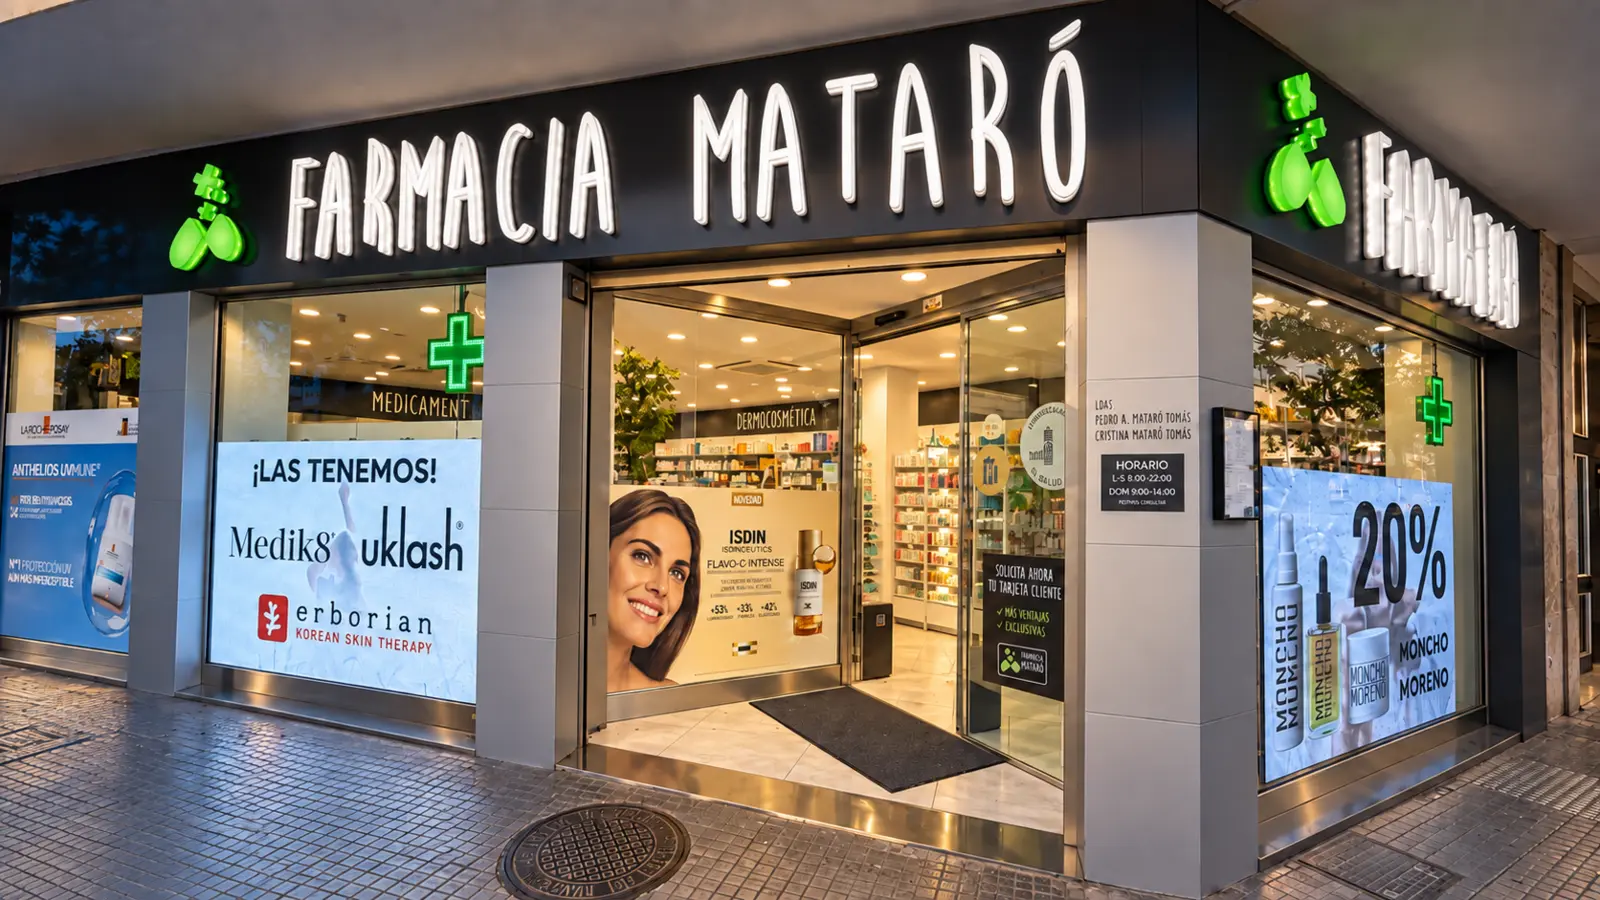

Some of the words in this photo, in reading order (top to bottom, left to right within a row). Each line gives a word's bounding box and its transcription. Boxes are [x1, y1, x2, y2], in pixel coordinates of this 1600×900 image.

[286, 111, 616, 262] FARMACIA
[693, 19, 1087, 225] MATARÓ
[372, 391, 470, 419] MEDICAMENT
[737, 405, 816, 430] DERMOCOSMÉTICA
[1095, 414, 1119, 425] PEDRO
[1121, 413, 1130, 424] A.
[1132, 411, 1163, 424] MATARÓ
[1165, 410, 1192, 424] TOMÁS
[1095, 430, 1130, 441] CRISTINA
[1132, 426, 1163, 440] MATARÓ
[1165, 426, 1192, 440] TOMÁS
[12, 463, 58, 476] ANTHELIOS
[252, 458, 301, 488] ¡LAS
[308, 458, 437, 484] TENEMOS!
[1116, 460, 1169, 470] HORARIO
[1112, 474, 1126, 482] L-S
[733, 494, 762, 505] NOVEDAD
[1109, 488, 1130, 496] DOM
[730, 530, 766, 544] ISDIN
[1352, 500, 1447, 608] 20%
[22, 560, 61, 574] PROTECCIÓN
[62, 563, 72, 575] UV
[707, 559, 747, 569] FLAVO-C
[748, 558, 785, 567] INTENSE
[995, 564, 1026, 580] SOLICITA
[1028, 566, 1054, 582] AHORA
[800, 581, 817, 590] ISDIN
[988, 579, 997, 592] TU
[999, 580, 1029, 596] TARJETA
[1031, 584, 1062, 600] CLIENTE
[296, 601, 432, 635] erborian
[1019, 609, 1050, 623] VENTAJAS
[1005, 621, 1046, 637] EXCLUSIVAS
[295, 628, 340, 643] KOREAN
[345, 633, 373, 648] SKIN
[378, 637, 433, 654] THERAPY
[1399, 632, 1449, 662] MONCHO
[1021, 660, 1044, 673] MATARÓ
[1275, 605, 1288, 732] MONCHO
[1350, 660, 1387, 685] MONCHO
[1399, 667, 1449, 701] MORENO
[1350, 681, 1387, 707] MORENO
